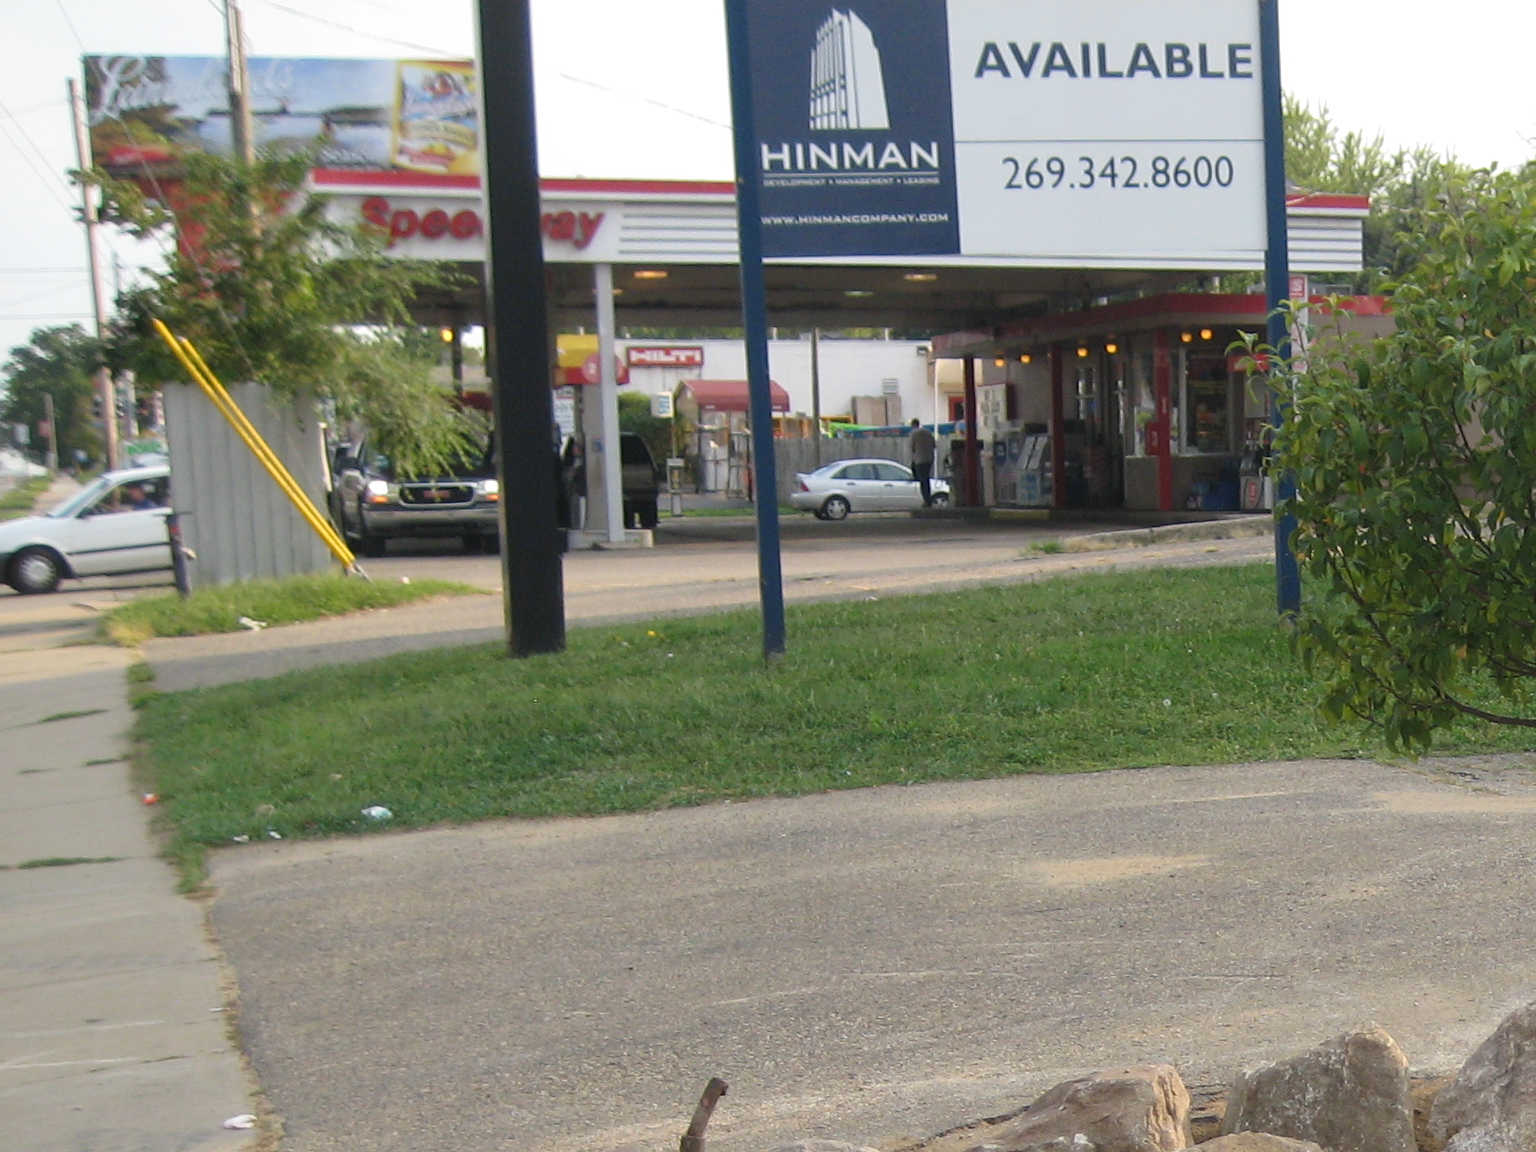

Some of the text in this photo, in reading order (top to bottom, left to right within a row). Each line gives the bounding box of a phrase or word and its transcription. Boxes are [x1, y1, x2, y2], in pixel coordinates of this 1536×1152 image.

[974, 41, 1254, 79] AVAILABLE
[760, 141, 940, 171] HINMAN
[762, 178, 826, 187] DEVELOPMENT
[835, 177, 895, 186] MANAGEMENT
[1001, 155, 1235, 190] 269.342.8600
[362, 196, 606, 251] Speeay
[760, 212, 949, 226] WWW.HINMANCOMPANY.COM
[628, 348, 702, 366] HILTI
